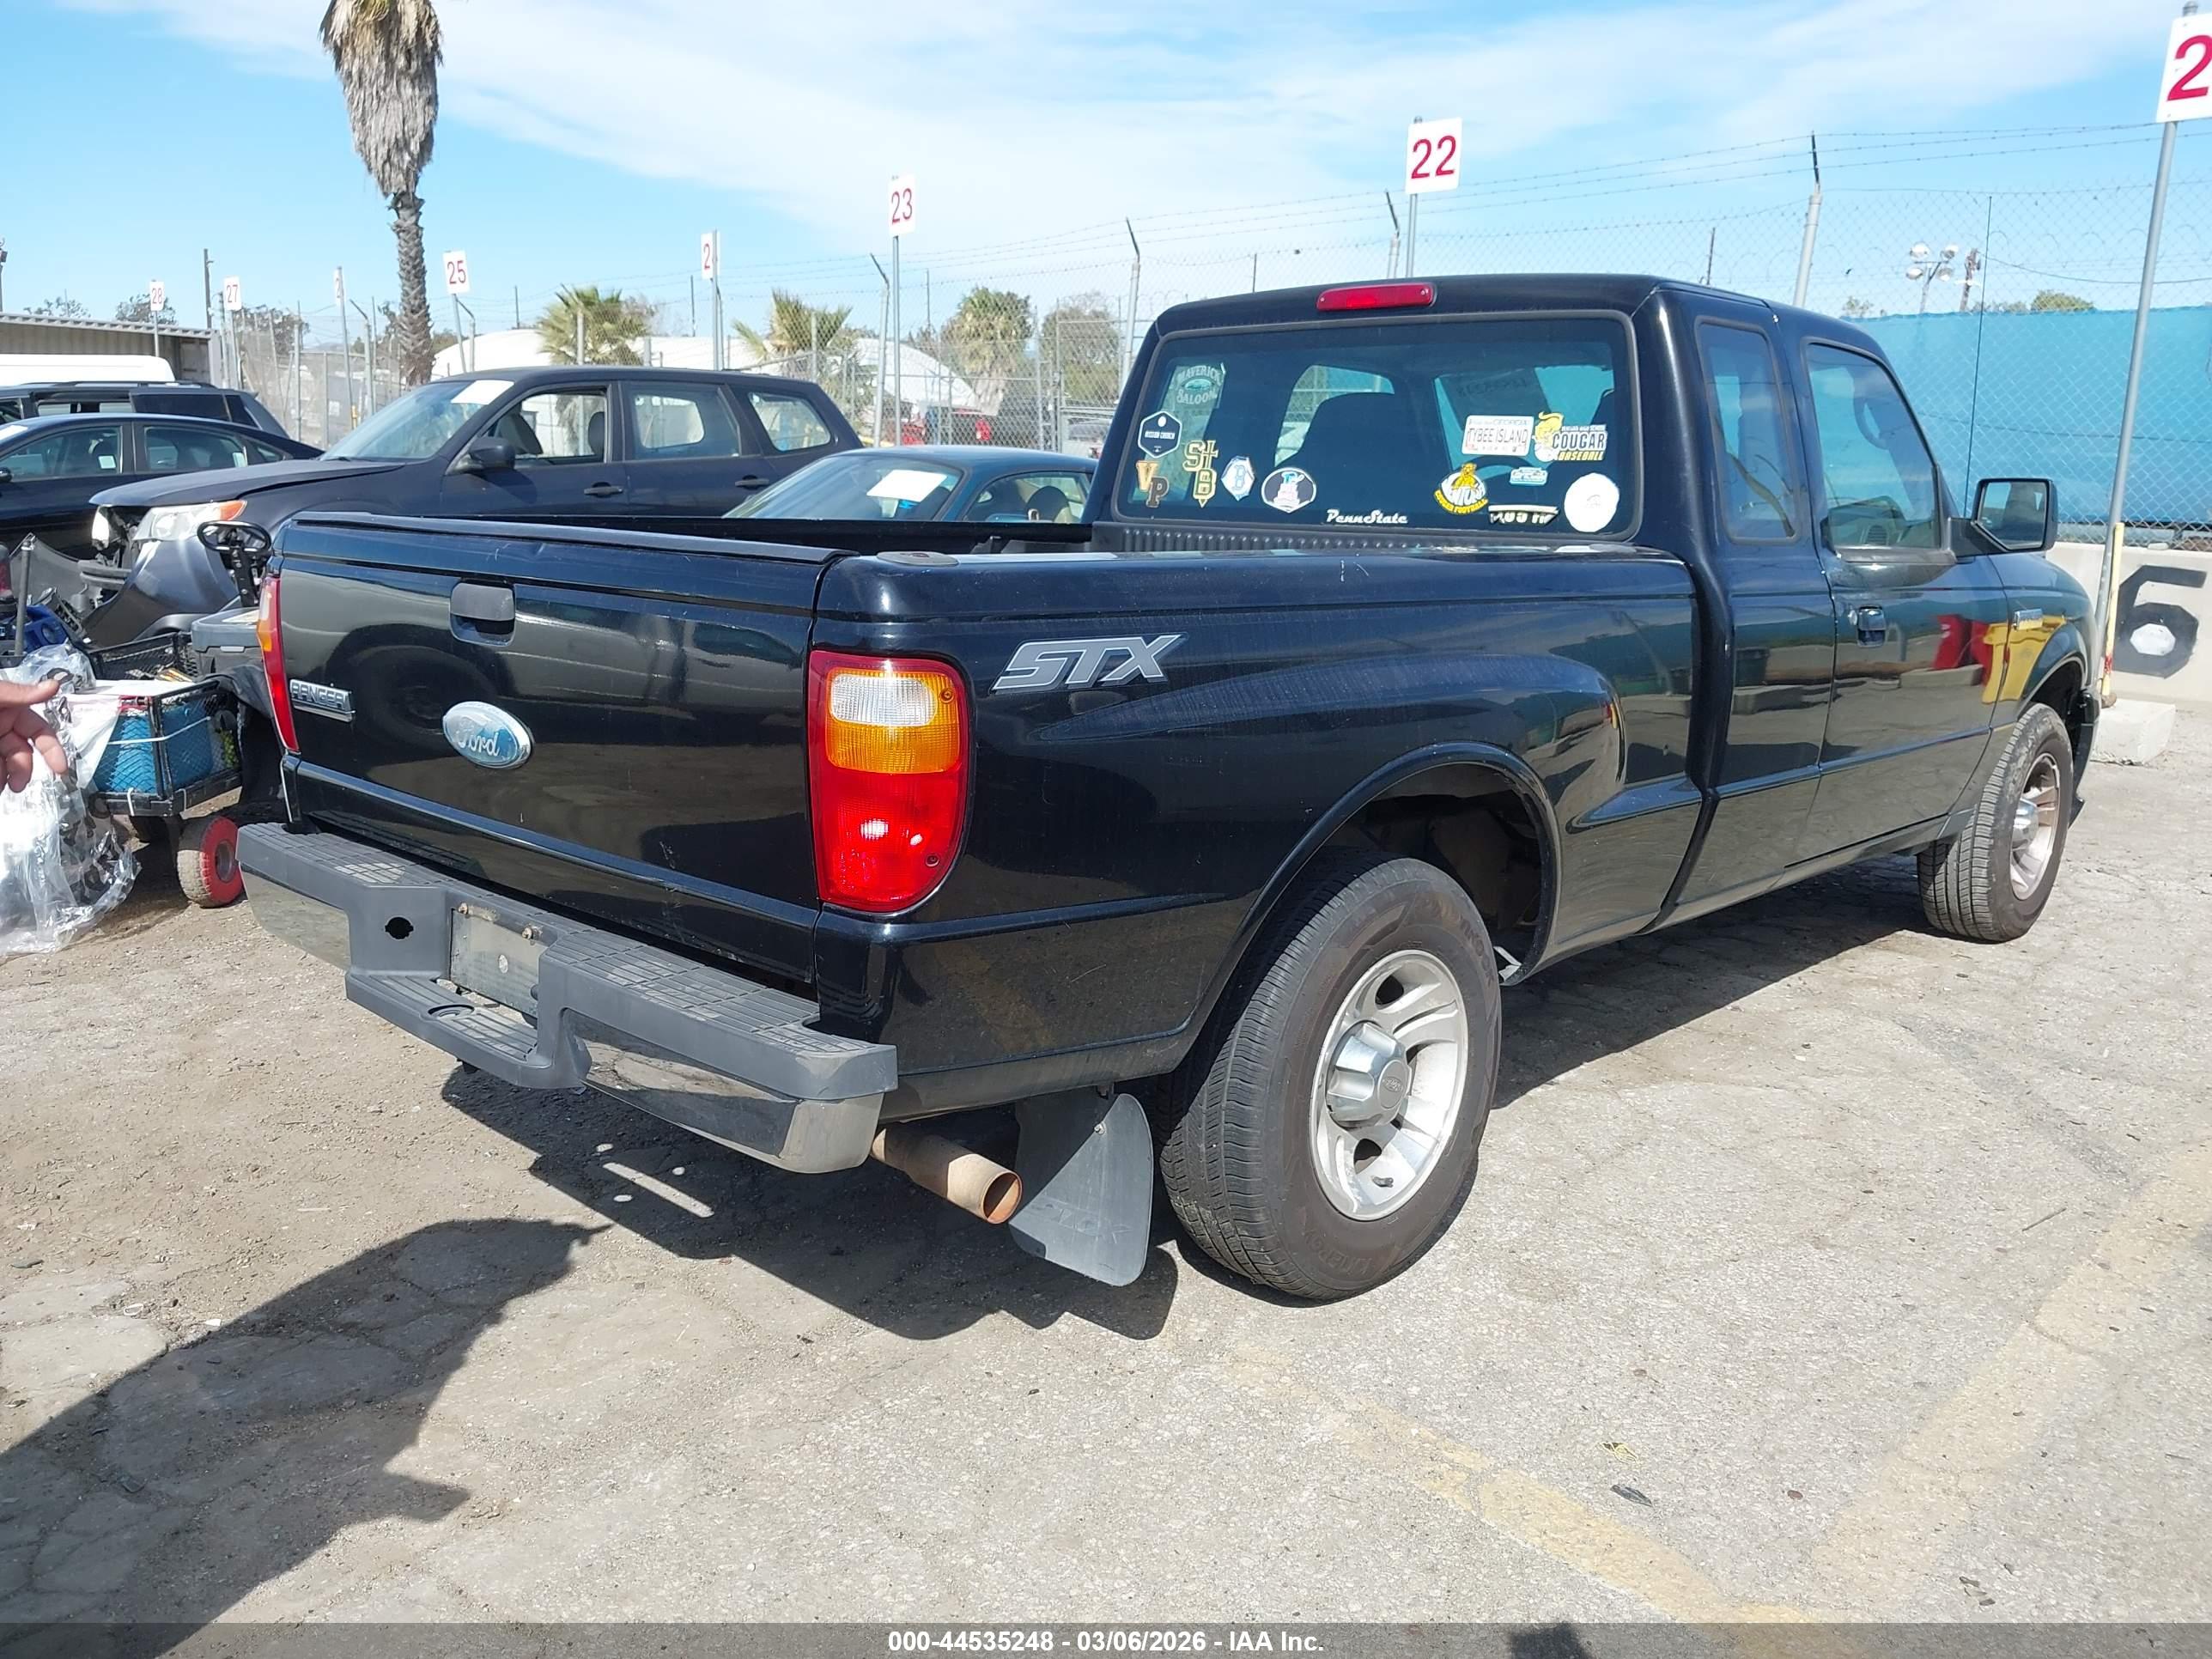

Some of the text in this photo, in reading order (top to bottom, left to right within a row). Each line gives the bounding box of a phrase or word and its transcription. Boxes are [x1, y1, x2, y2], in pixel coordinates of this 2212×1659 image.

[1411, 135, 1456, 179] 22
[891, 188, 913, 224] 23
[448, 260, 466, 284] 25
[152, 288, 163, 304] 28
[226, 284, 238, 302] 27
[1467, 428, 1528, 444] TYBEE ISLAND
[1553, 433, 1605, 449] COUGAR
[1558, 451, 1604, 461] BASEBALL
[2112, 564, 2207, 679] 6
[990, 634, 1182, 690] STX
[290, 680, 348, 708] RANGER
[453, 716, 501, 757] Ford
